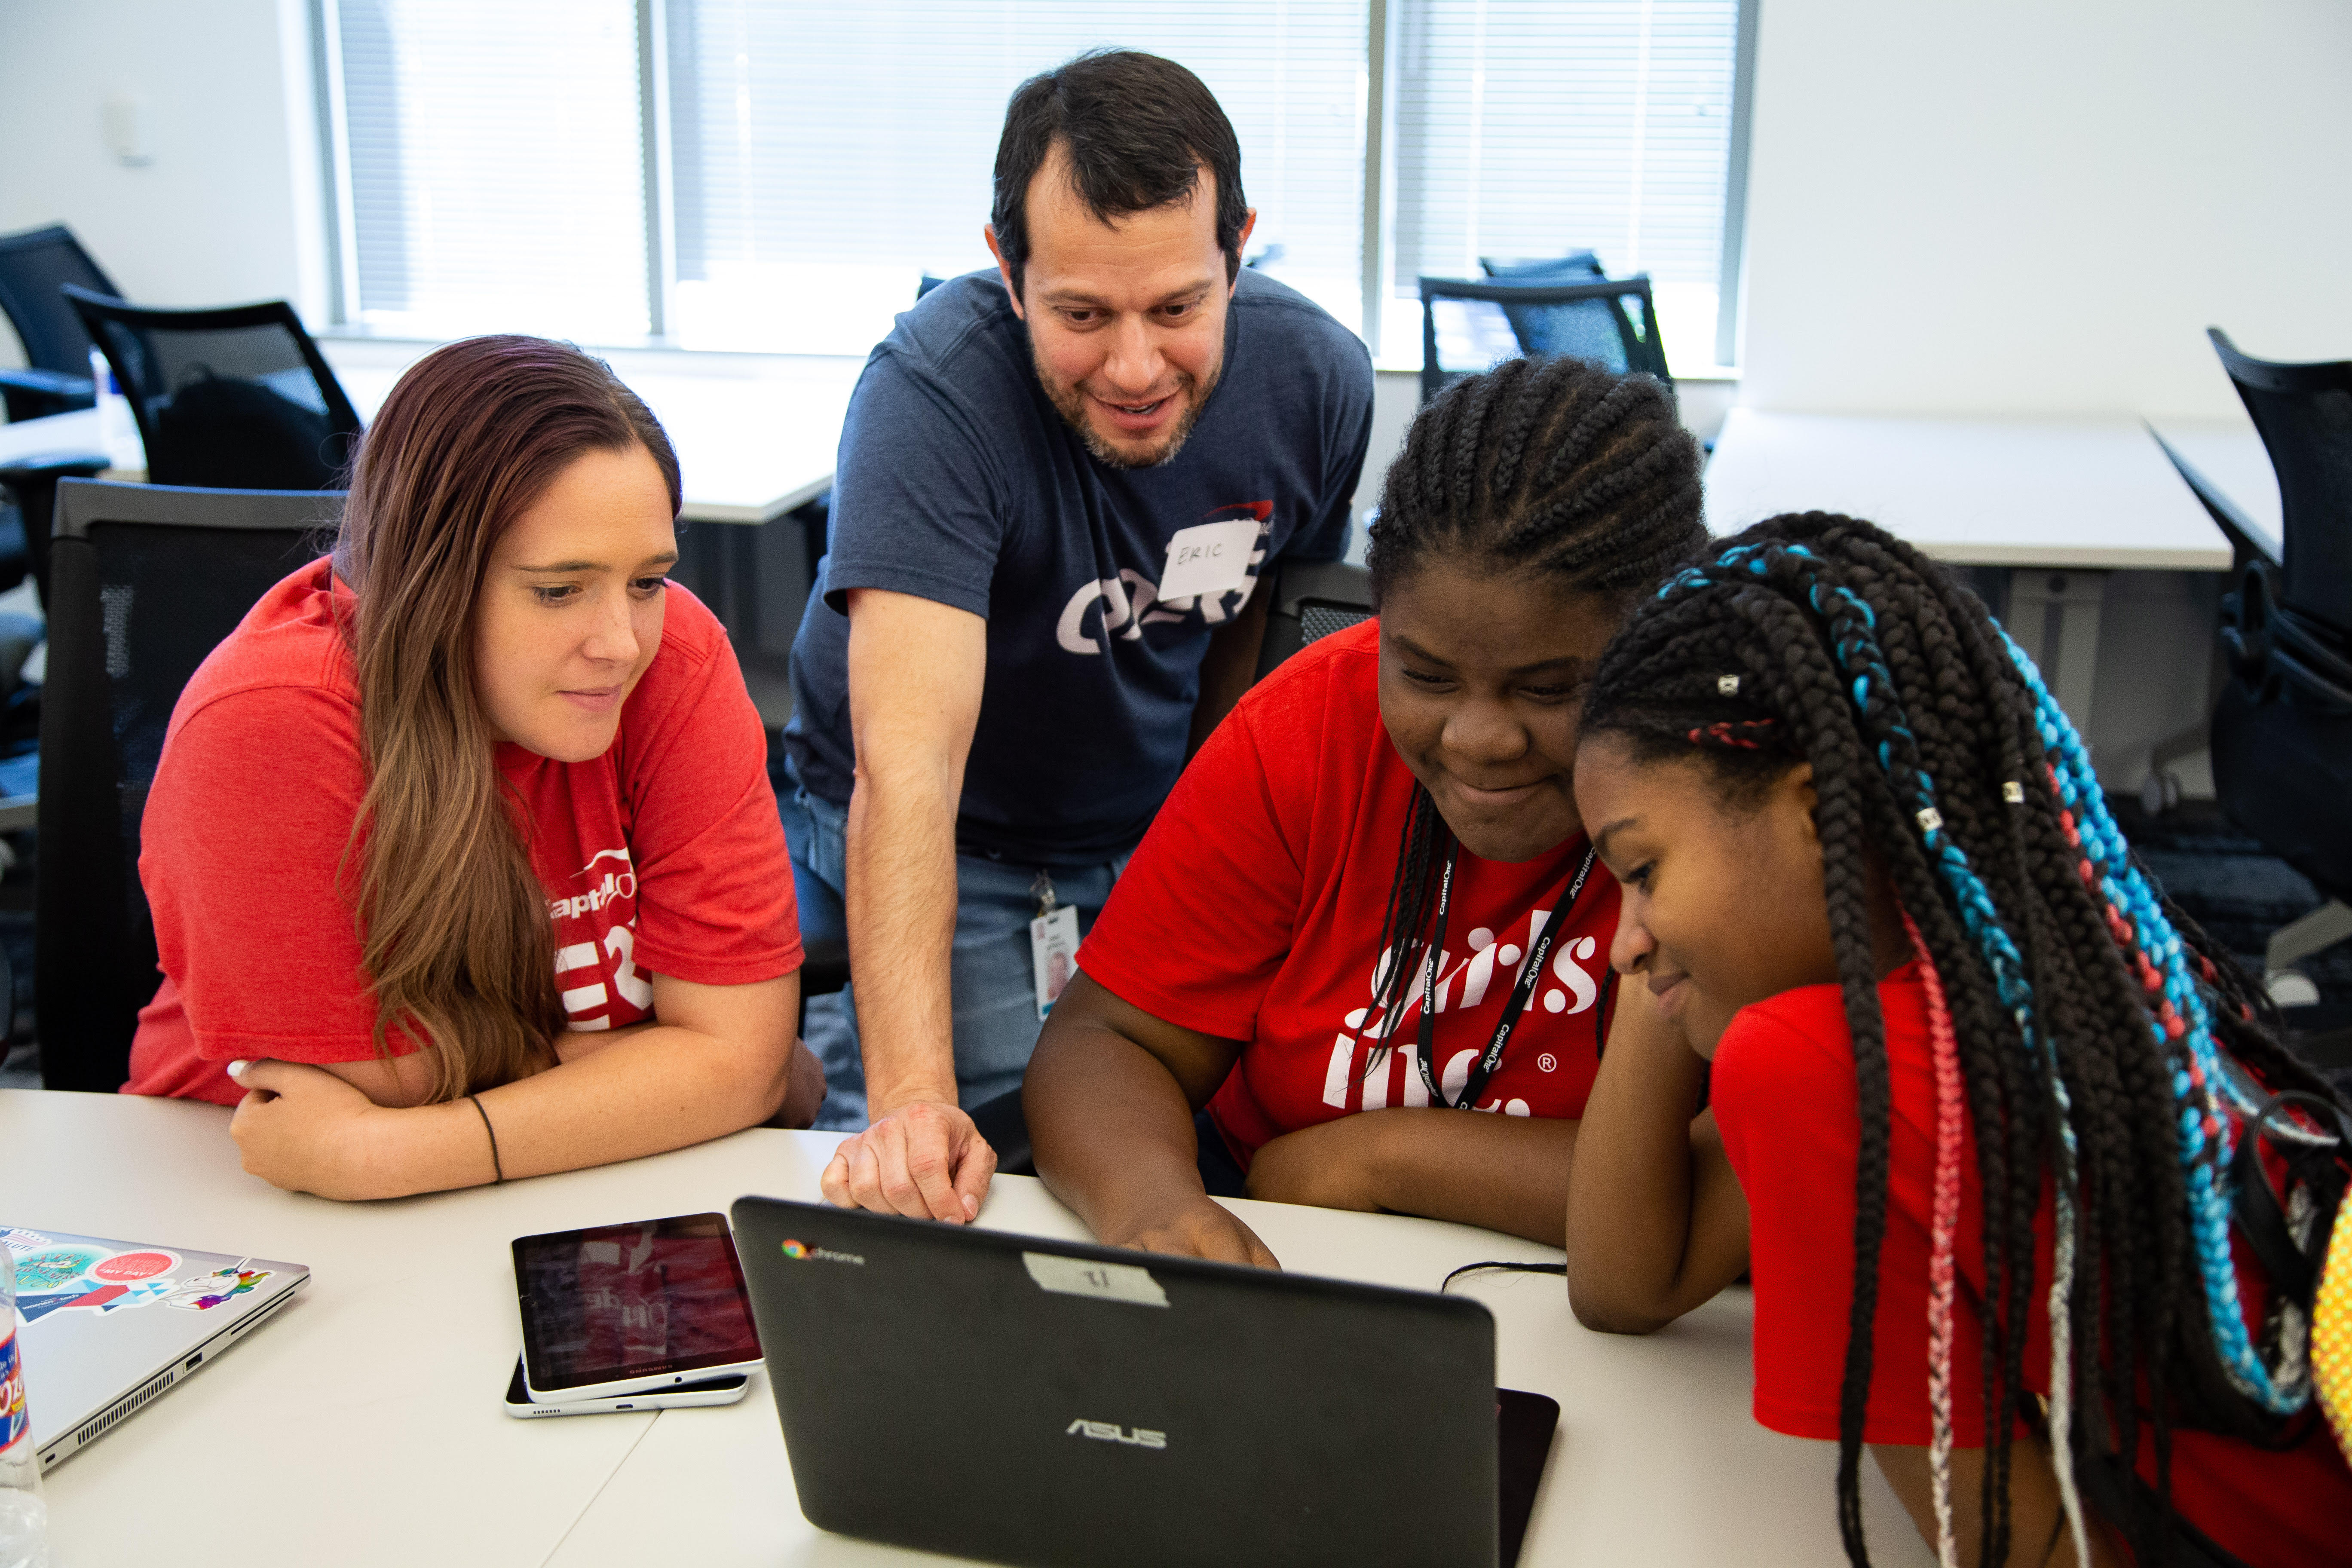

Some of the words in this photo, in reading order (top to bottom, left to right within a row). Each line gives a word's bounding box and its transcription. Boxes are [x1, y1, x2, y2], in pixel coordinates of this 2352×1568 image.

[1178, 543, 1222, 565] ERIC
[810, 1246, 866, 1265] chrome
[630, 1364, 672, 1374] SAMSUNG
[1066, 1418, 1167, 1449] ASUS
